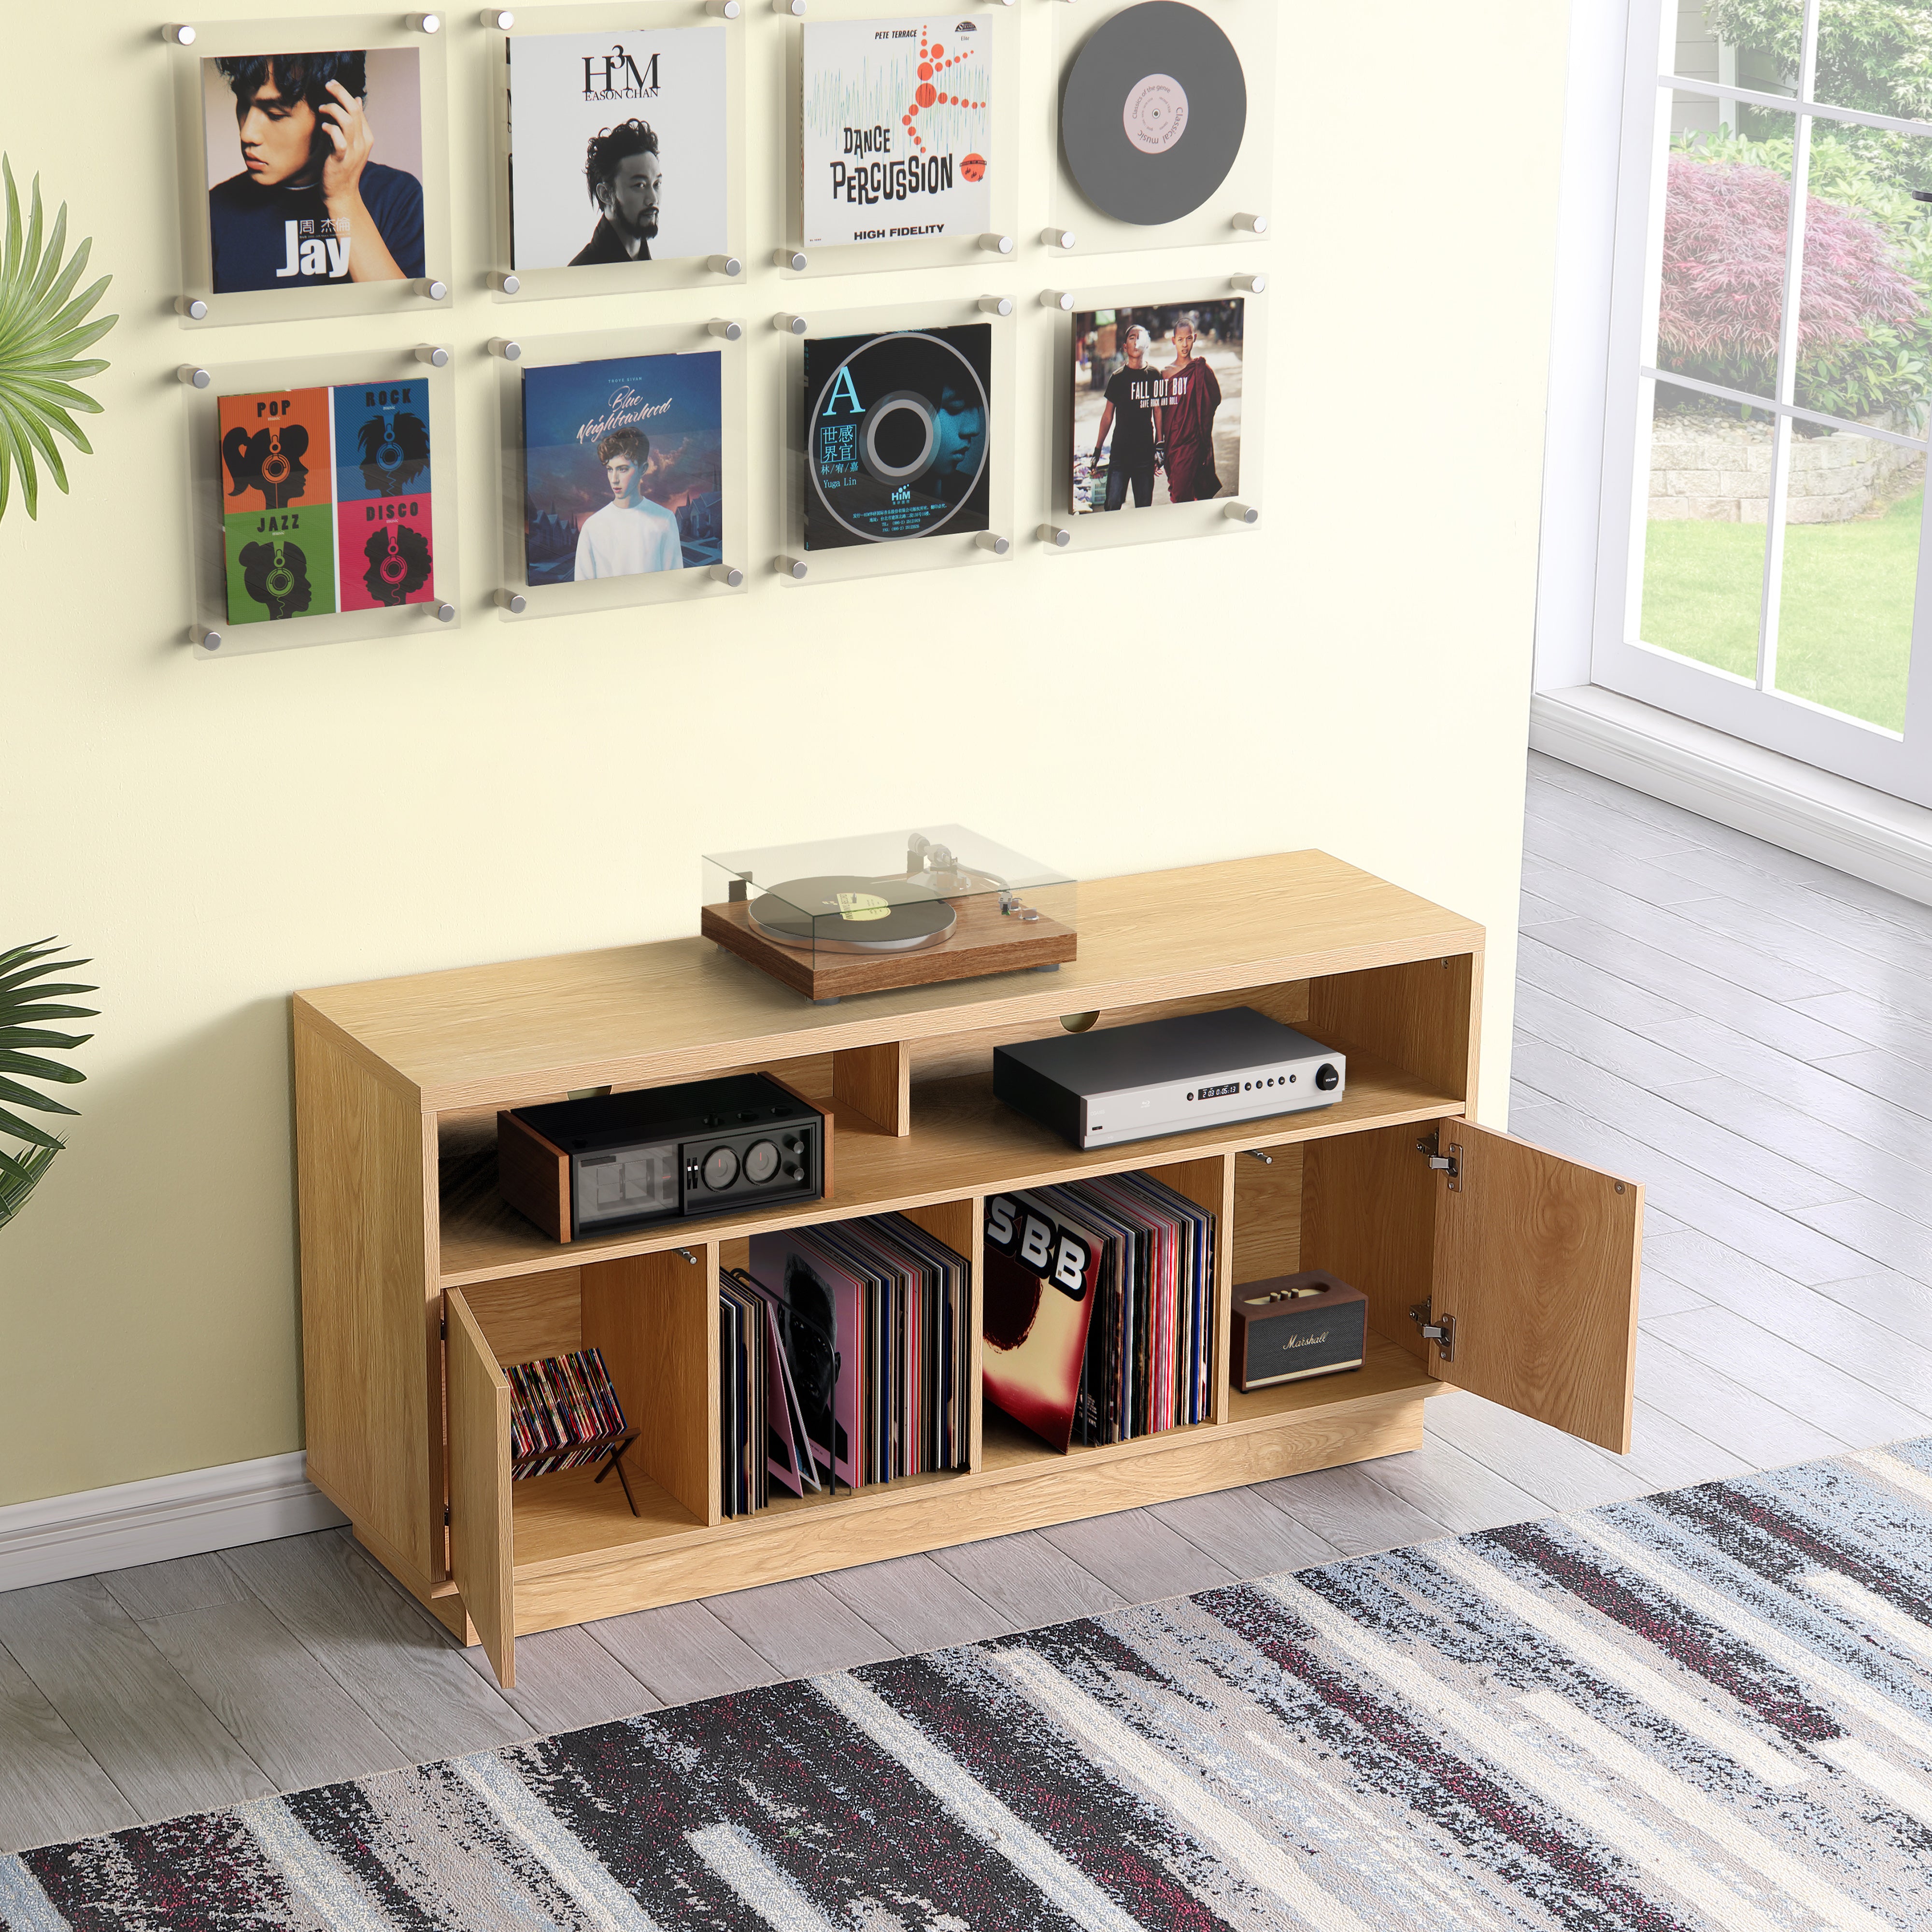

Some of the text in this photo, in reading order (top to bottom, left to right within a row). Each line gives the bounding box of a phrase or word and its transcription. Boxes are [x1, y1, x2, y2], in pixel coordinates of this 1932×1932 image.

[875, 29, 917, 40] PETE TERRACE
[585, 87, 658, 101] EASON CHAN
[1132, 96, 1143, 119] Classics
[1156, 85, 1171, 93] genre
[1163, 107, 1183, 143] Classical
[844, 125, 890, 159] DANCE
[1137, 130, 1159, 144] music
[830, 153, 952, 205] PERCUSSION
[299, 217, 350, 234] 周 杰倫
[854, 224, 944, 240] HIGH FIDELITY
[276, 220, 351, 278] Jay
[366, 388, 411, 407] ROCK
[823, 366, 866, 416] A
[1131, 377, 1188, 400] FALL OUT BOY
[608, 385, 643, 412] Blue
[1140, 399, 1149, 408] SAVE
[1150, 398, 1159, 407] ROCK
[1169, 397, 1178, 405] ROLL
[257, 400, 290, 417] POP
[576, 398, 672, 444] Neighbourhood
[824, 477, 856, 489] Yuga Lin
[366, 501, 418, 522] DISCO
[257, 514, 299, 533] JAZZ
[1216, 1086, 1236, 1095] 0:05:13
[987, 1196, 1085, 1290] SBB
[1283, 1331, 1329, 1350] Marshall
